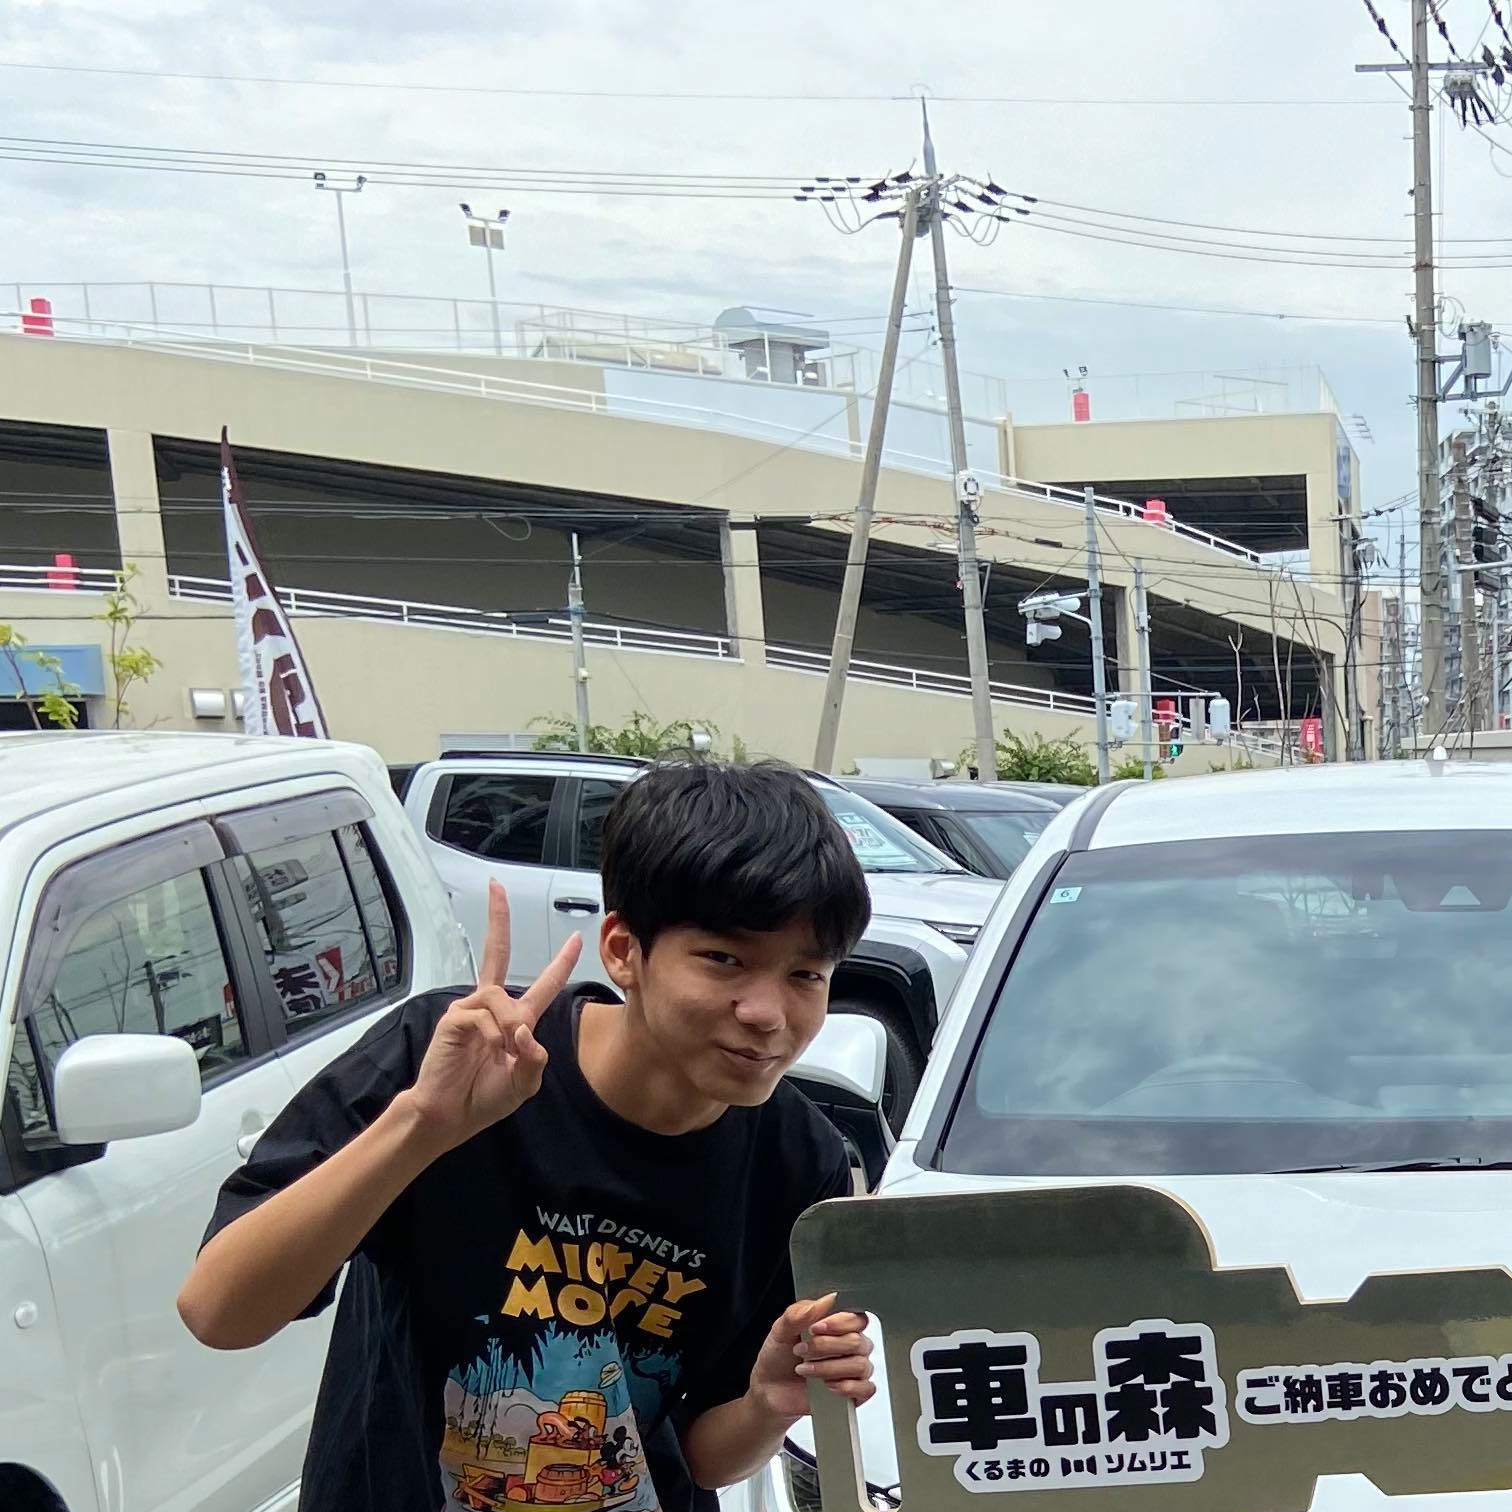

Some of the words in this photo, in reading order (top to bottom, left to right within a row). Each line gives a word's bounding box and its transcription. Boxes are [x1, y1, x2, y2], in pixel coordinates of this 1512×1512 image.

[505, 1229, 707, 1304] MICKEY
[536, 1206, 594, 1235] WALT
[598, 1217, 707, 1269] DISNEY'S
[923, 1332, 1217, 1450] 車の森
[965, 1457, 1050, 1481] くるまの
[1106, 1450, 1192, 1473] ソムリエ
